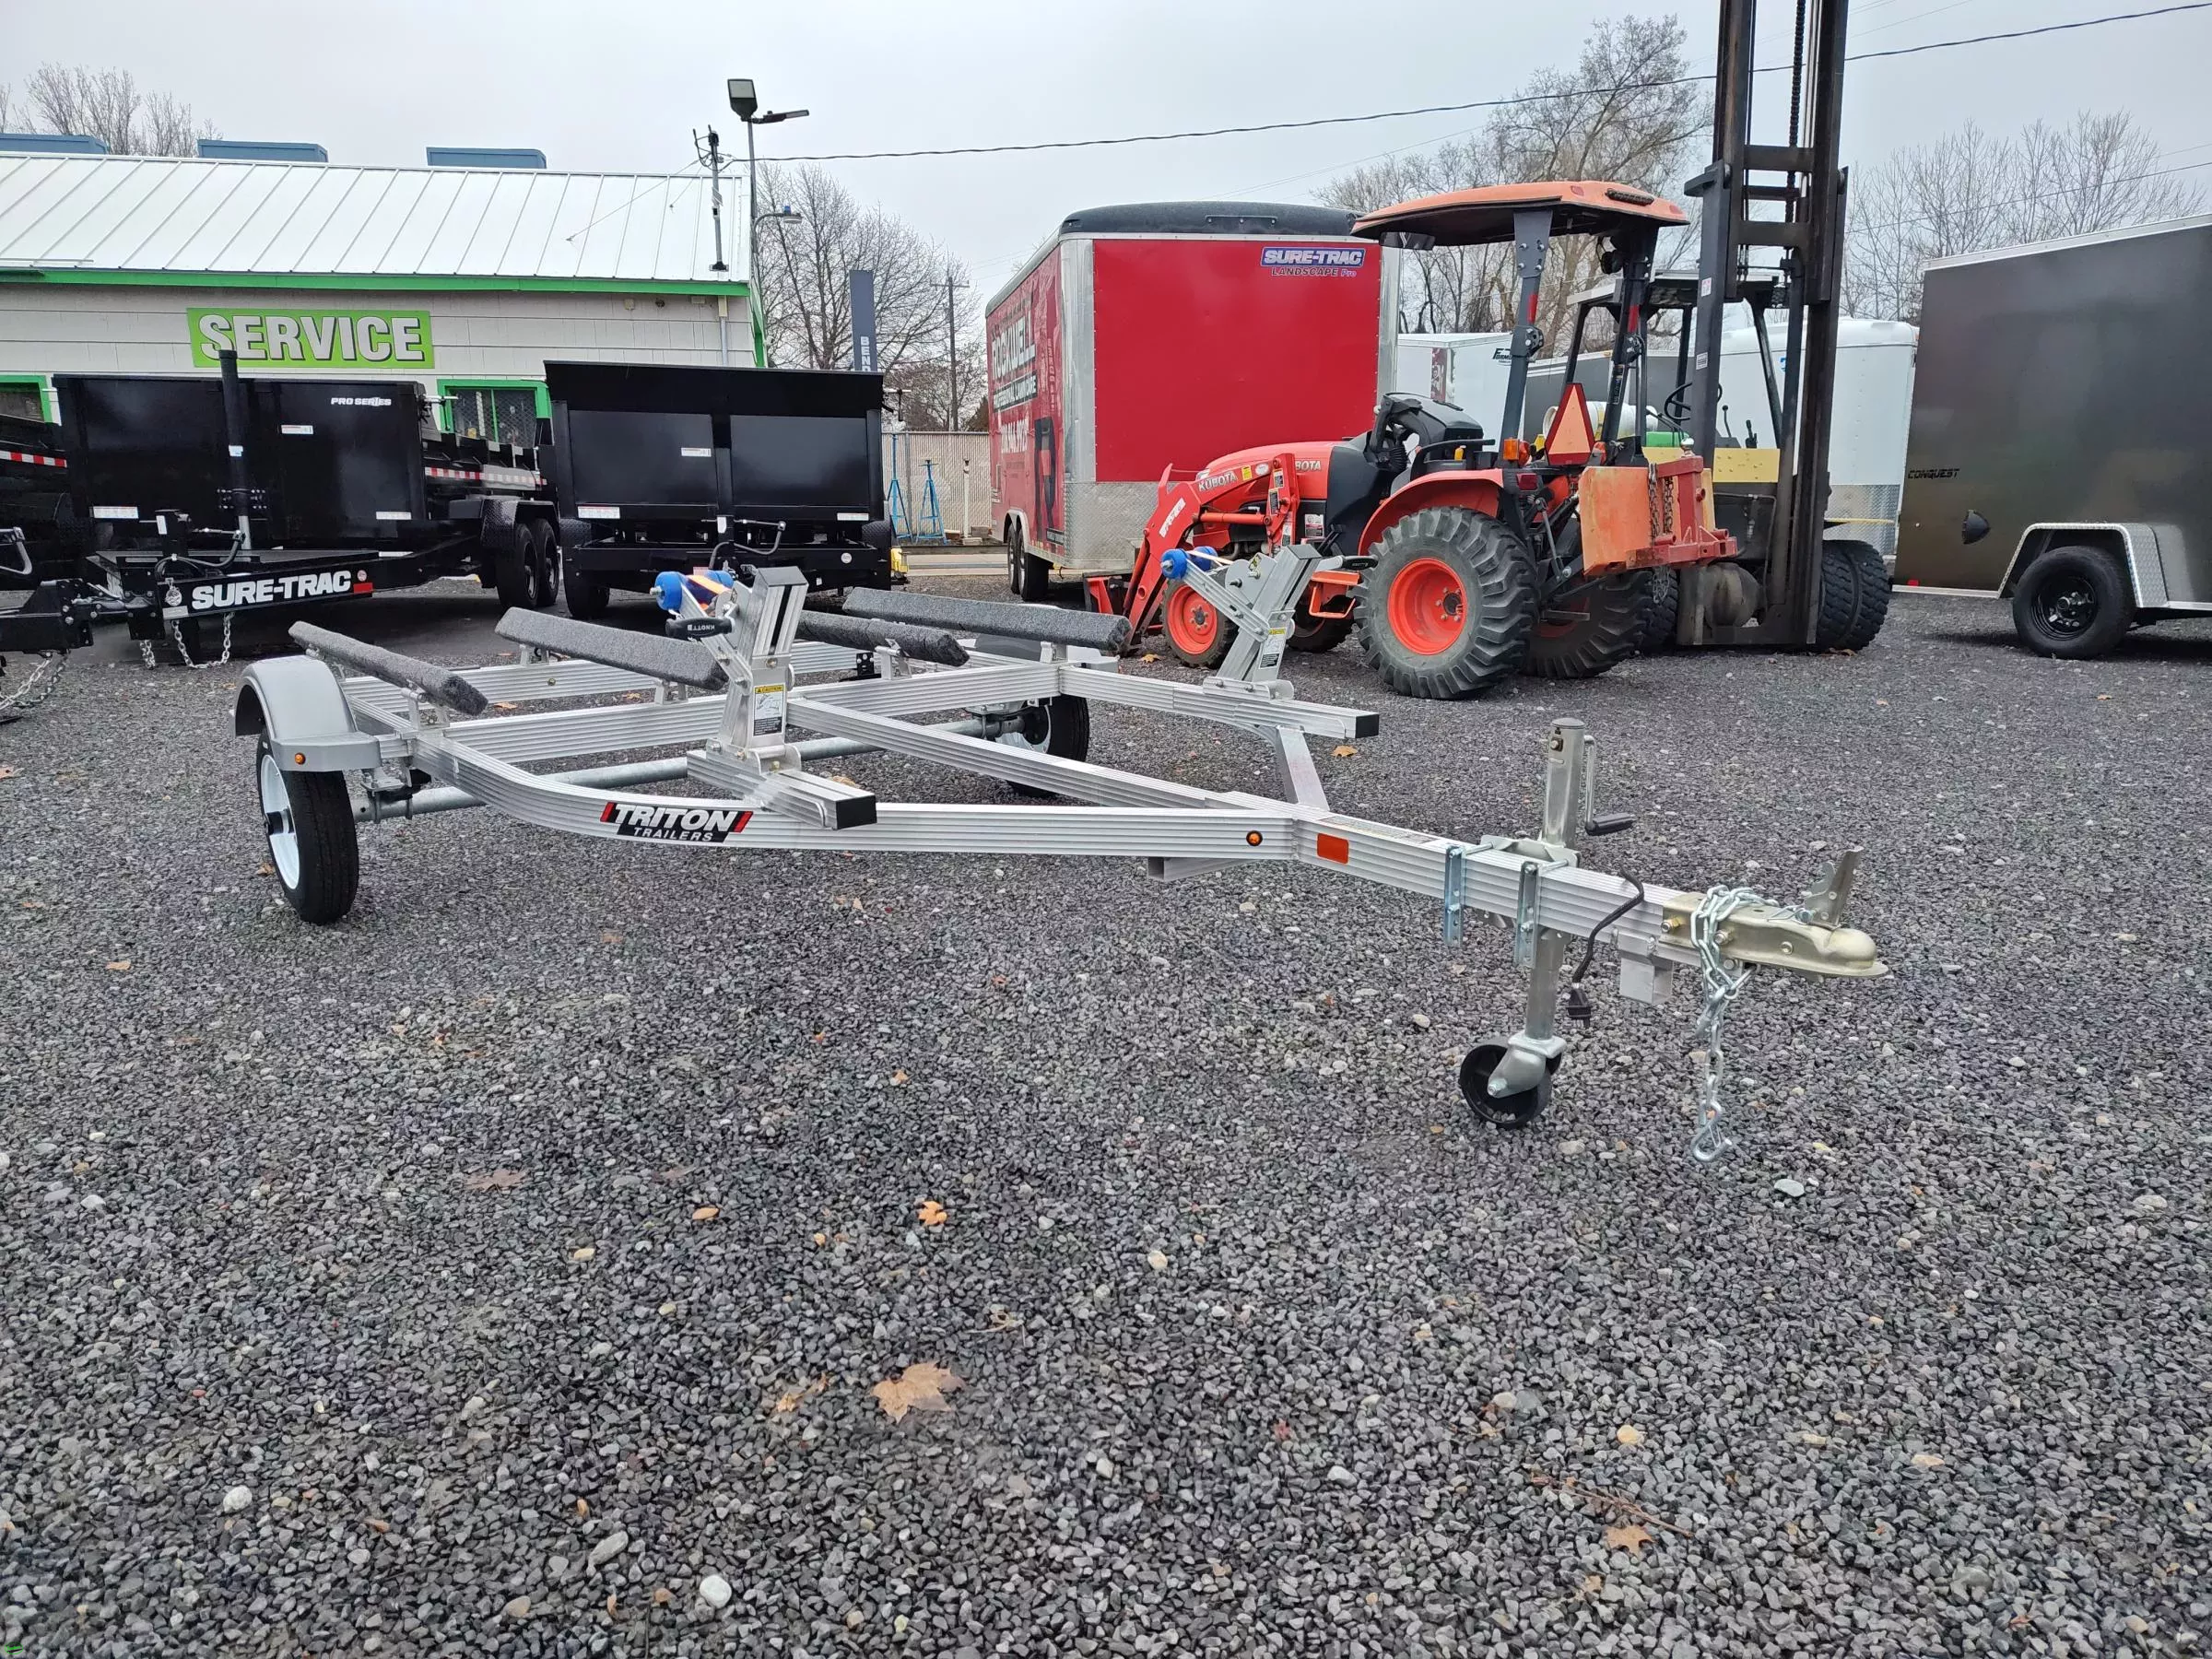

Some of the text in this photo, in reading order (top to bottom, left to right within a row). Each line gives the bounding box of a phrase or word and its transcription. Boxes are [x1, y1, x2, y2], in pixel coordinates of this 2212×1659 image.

[1264, 250, 1362, 265] SURE-TRAC
[1272, 267, 1338, 276] LANDSCAPE
[198, 314, 425, 361] SERVICE
[330, 397, 392, 406] PRO SERIES
[1294, 460, 1322, 472] BOTA
[1907, 468, 1960, 479] CONQUEST
[1198, 471, 1239, 492] KUBOTA
[192, 571, 351, 610] SURE-TRAC
[615, 804, 738, 832] TRITON
[633, 827, 714, 842] TRAILERS
